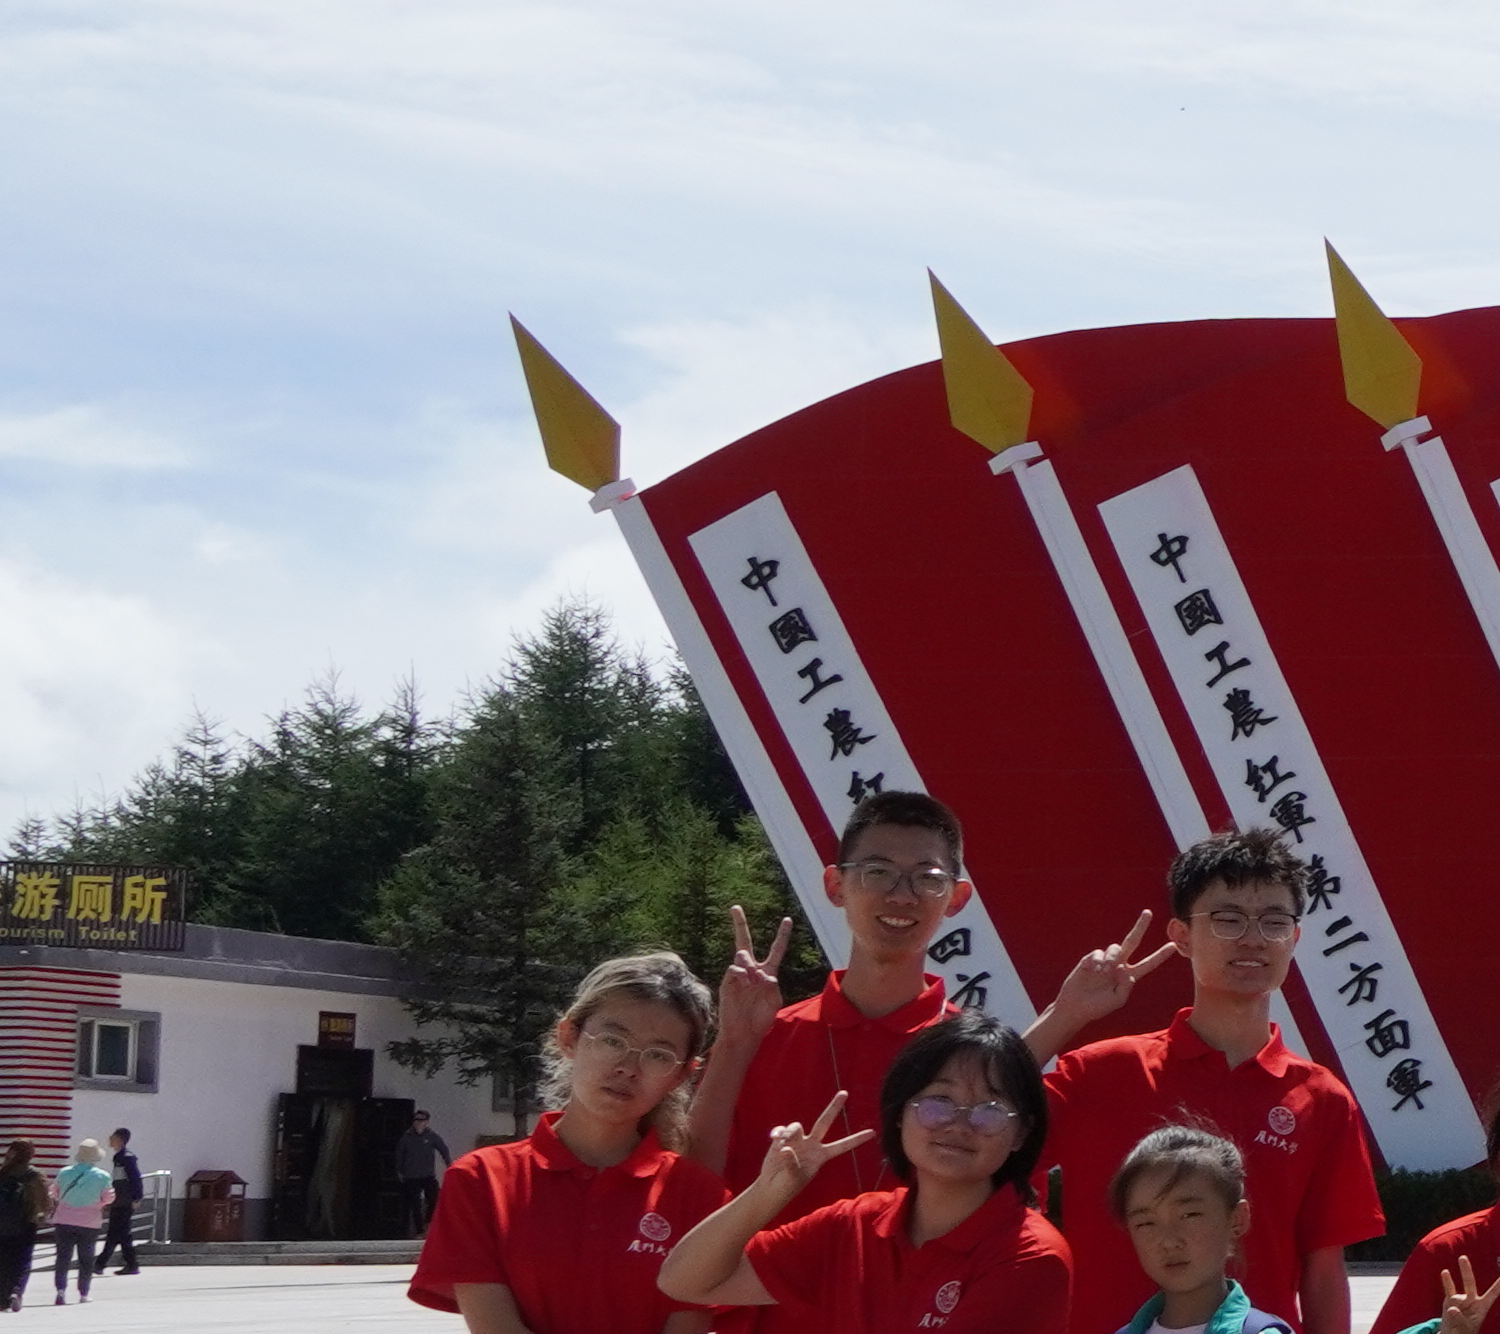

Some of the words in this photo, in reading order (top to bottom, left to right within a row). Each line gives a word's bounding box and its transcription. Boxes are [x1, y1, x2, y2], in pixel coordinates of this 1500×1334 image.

[0, 870, 168, 924] 游厕所
[0, 925, 65, 939] ourism
[79, 926, 138, 942] Toilet
